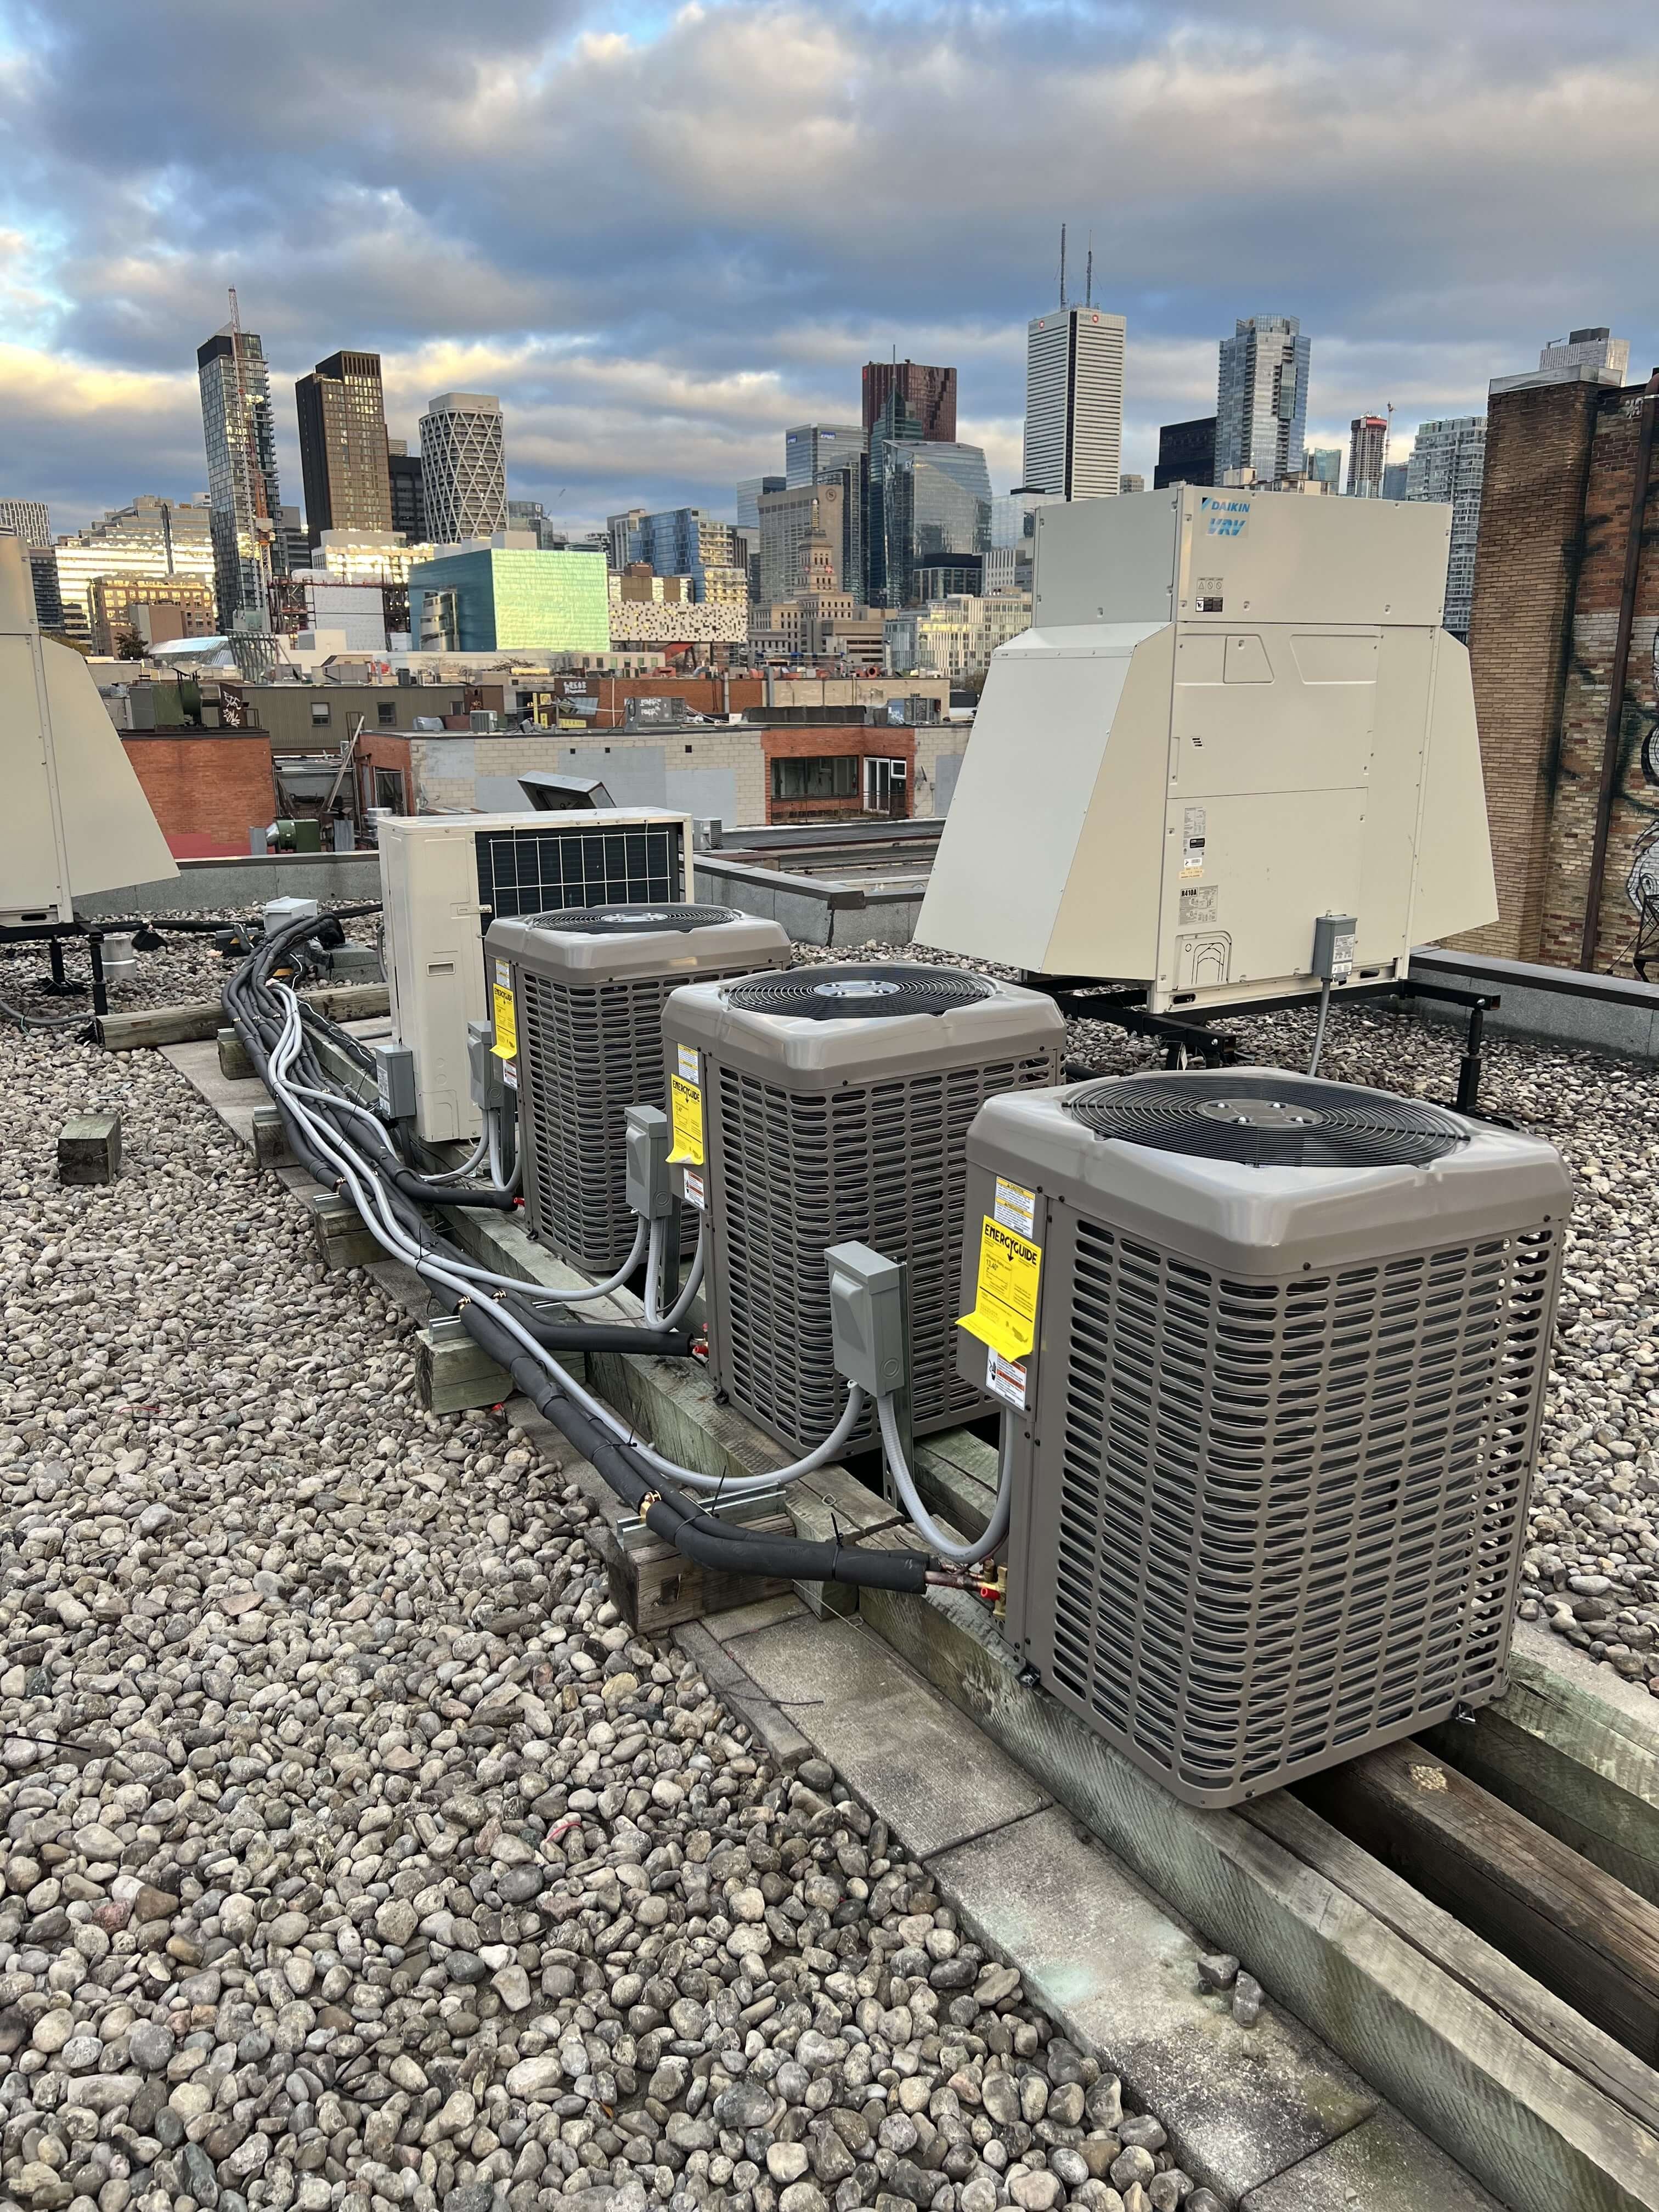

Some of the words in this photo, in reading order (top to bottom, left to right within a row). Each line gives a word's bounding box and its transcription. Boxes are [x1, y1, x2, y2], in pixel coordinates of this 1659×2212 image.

[1211, 501, 1250, 512] DAIKIN
[1207, 518, 1247, 536] VRV
[1181, 889, 1197, 897] R410A
[985, 1223, 1037, 1266] ENERGYGUIDE
